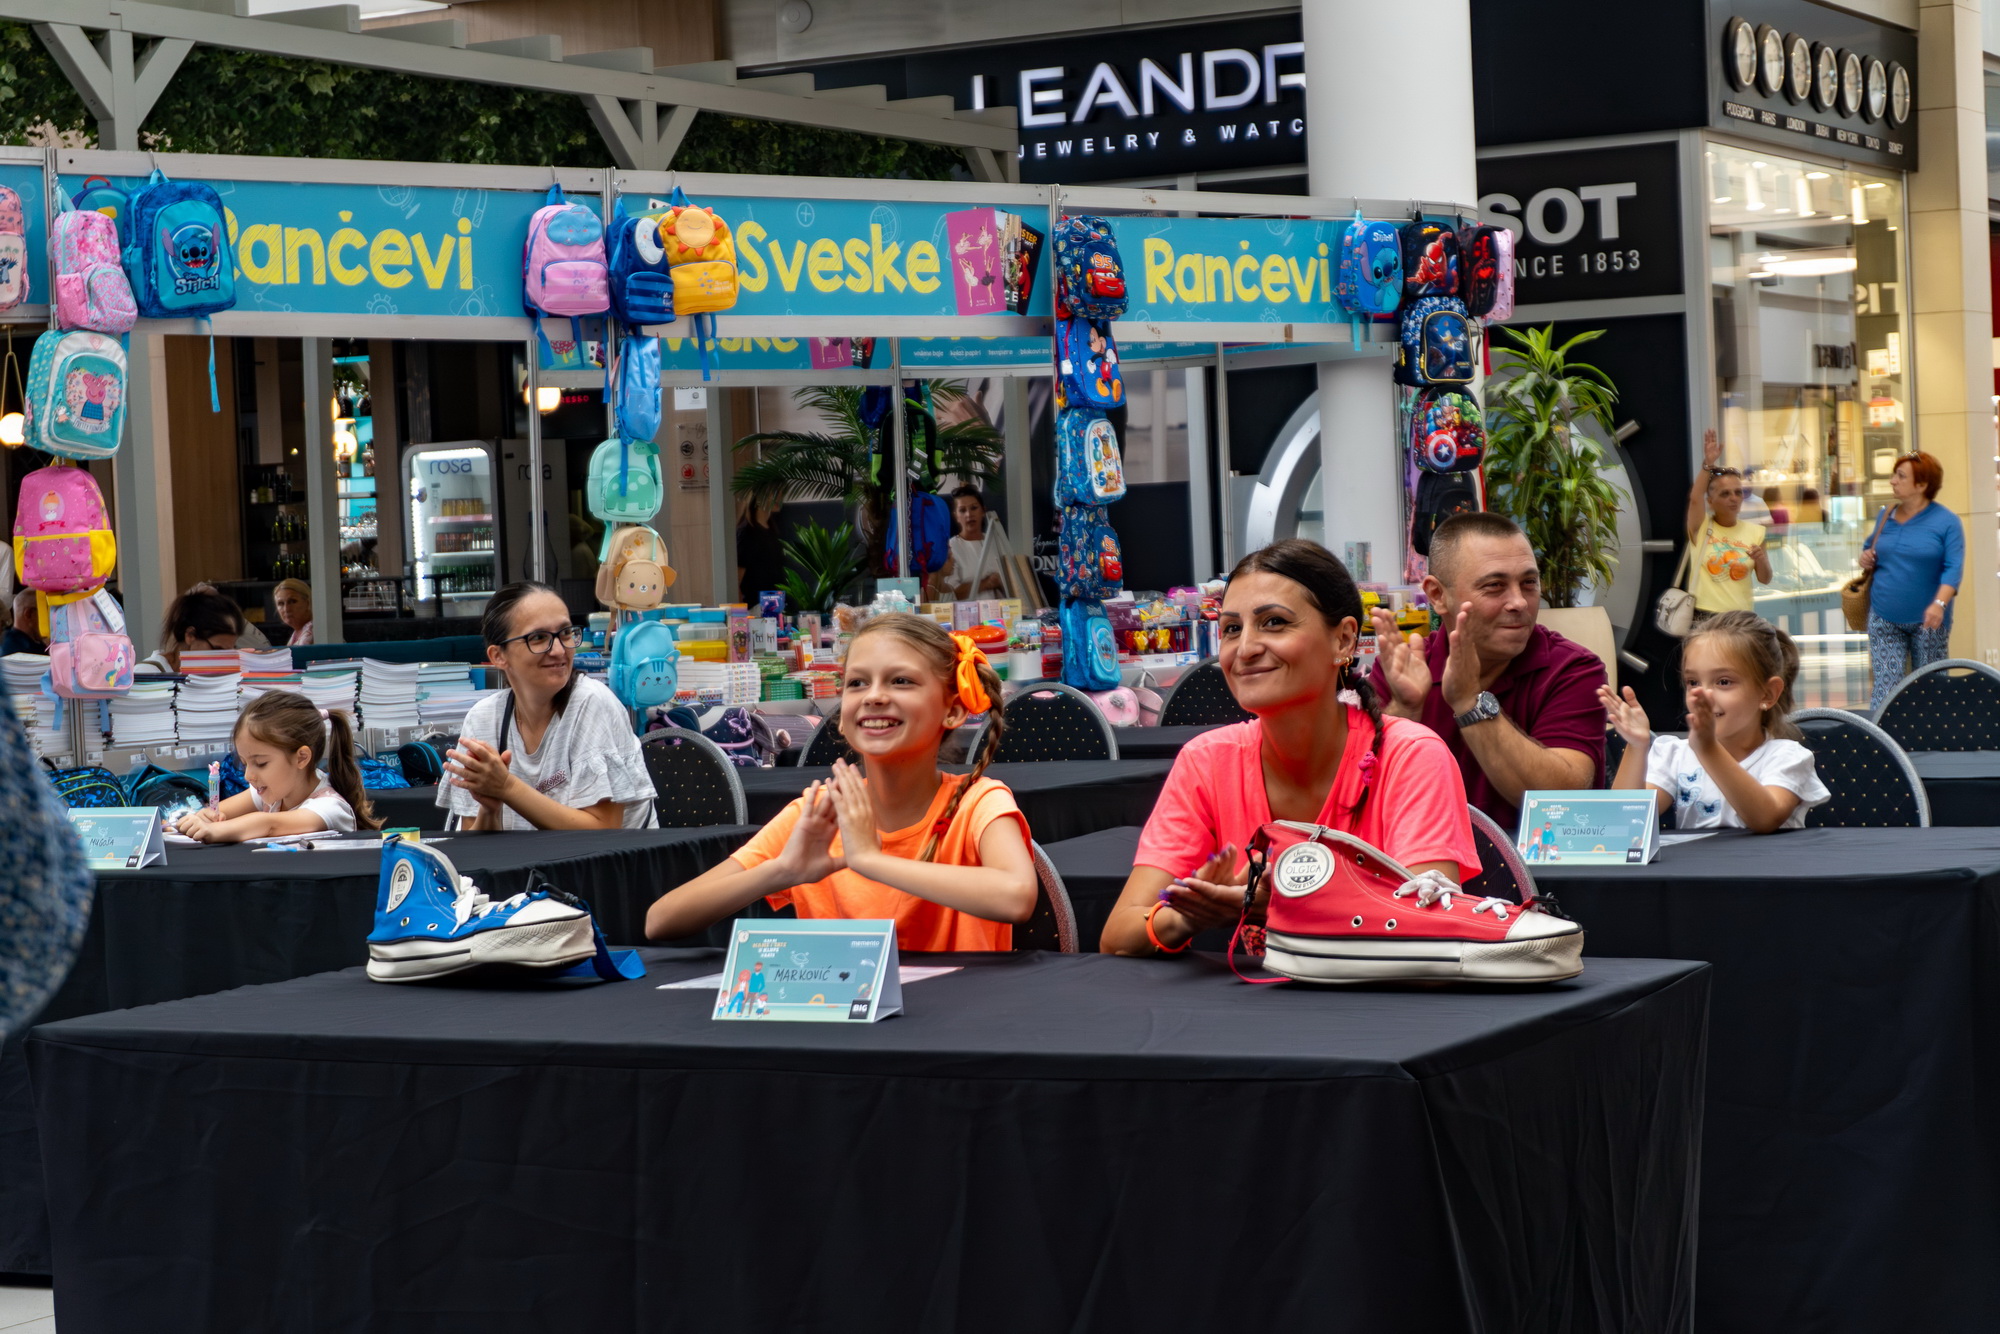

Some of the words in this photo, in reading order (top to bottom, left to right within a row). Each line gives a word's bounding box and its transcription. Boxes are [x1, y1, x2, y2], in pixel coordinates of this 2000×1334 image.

[1726, 102, 1755, 121] PODGORICA
[1761, 111, 1777, 126] PARIS
[1786, 117, 1806, 132] LONDON
[1815, 123, 1830, 138] DUBAI
[1017, 132, 1160, 160] JEWELRY
[1184, 128, 1197, 145] &
[1219, 118, 1304, 140] WATC
[1477, 181, 1638, 245] SOT
[738, 221, 941, 294] Sveske
[1143, 237, 1331, 304] Rančevi
[1515, 255, 1564, 279] NCE
[1580, 249, 1641, 274] 1853
[430, 458, 473, 475] rosa
[1285, 864, 1322, 876] OLGICA
[774, 965, 832, 982] MARKOVIĆ
[852, 1004, 868, 1012] BIG
